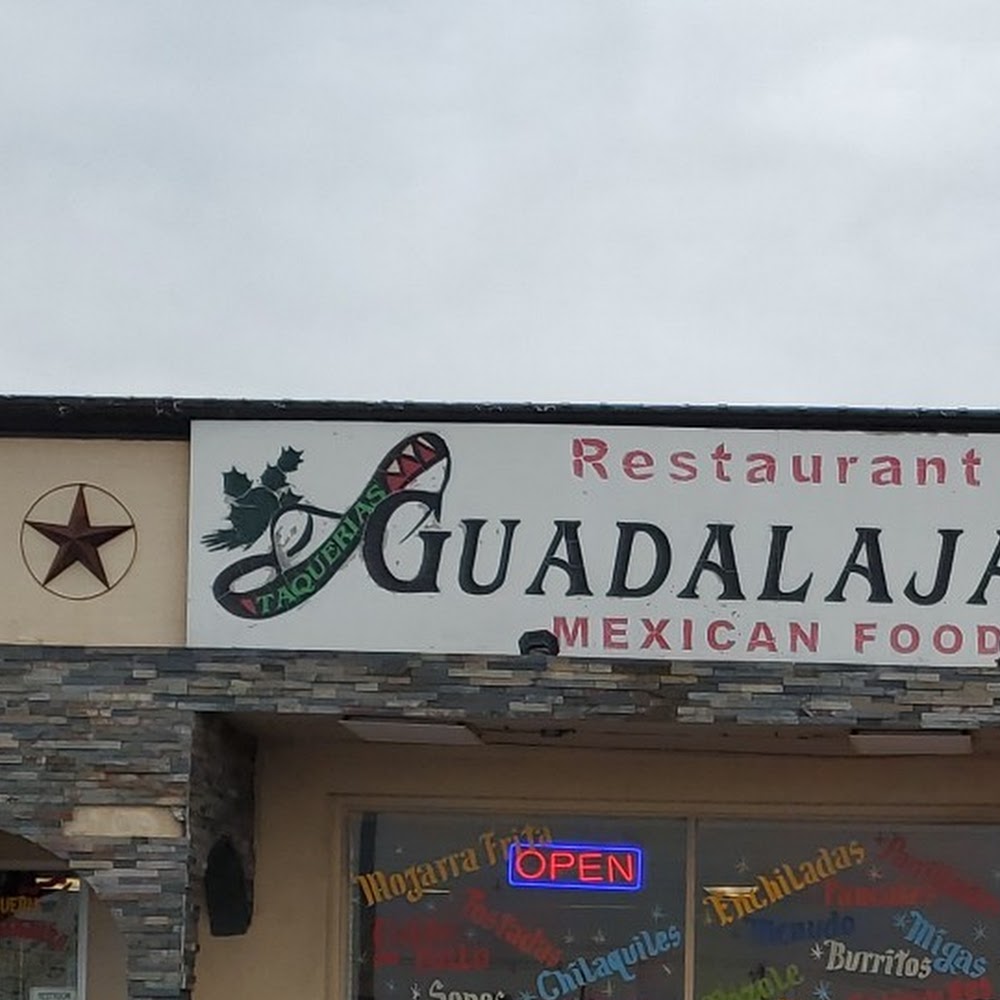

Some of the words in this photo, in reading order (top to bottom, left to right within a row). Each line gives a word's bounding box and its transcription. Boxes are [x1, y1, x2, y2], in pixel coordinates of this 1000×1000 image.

[571, 437, 982, 486] Restaurant
[256, 484, 387, 616] TAQUERIAS
[552, 615, 820, 653] MEXICAN
[514, 849, 635, 884] OPEN
[704, 841, 866, 927] Enchiladas
[535, 925, 682, 1000] Chilaquiles
[823, 939, 932, 979] Burritos
[903, 911, 988, 979] Migas
